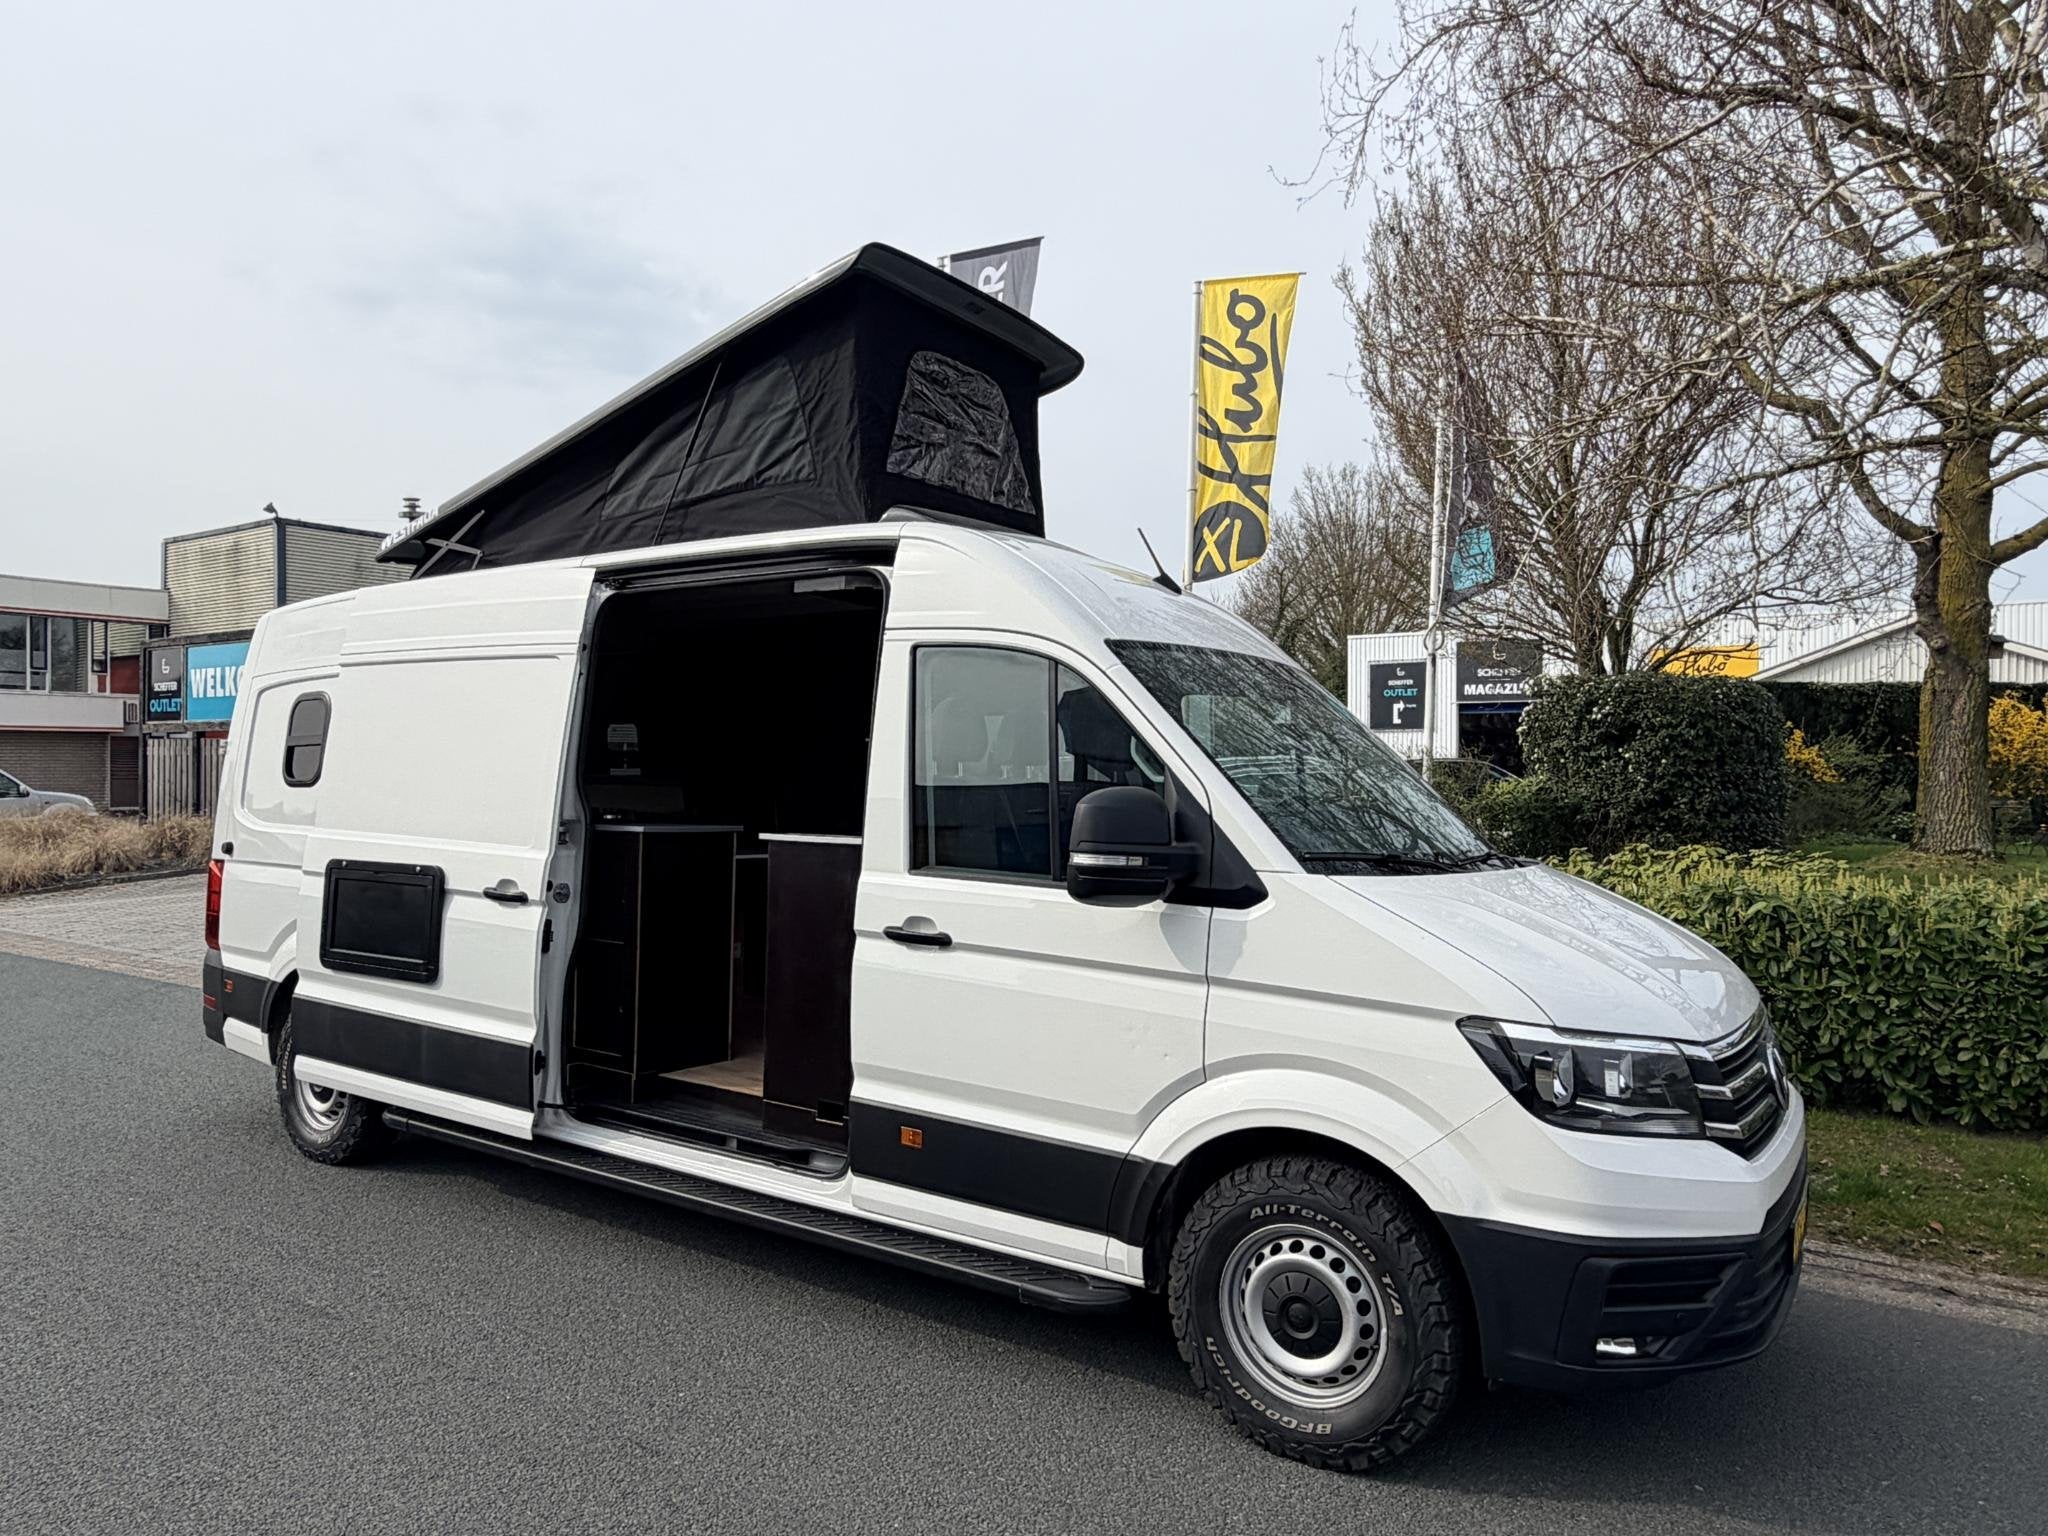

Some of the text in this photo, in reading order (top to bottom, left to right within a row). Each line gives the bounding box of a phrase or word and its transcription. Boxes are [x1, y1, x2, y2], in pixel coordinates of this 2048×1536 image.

[1194, 516, 1258, 574] XL
[149, 698, 182, 713] OUTLET
[1383, 688, 1418, 697] OUTLET
[1250, 1203, 1404, 1316] All-Terrain T/A
[1206, 1336, 1332, 1434] BFGoodrich
